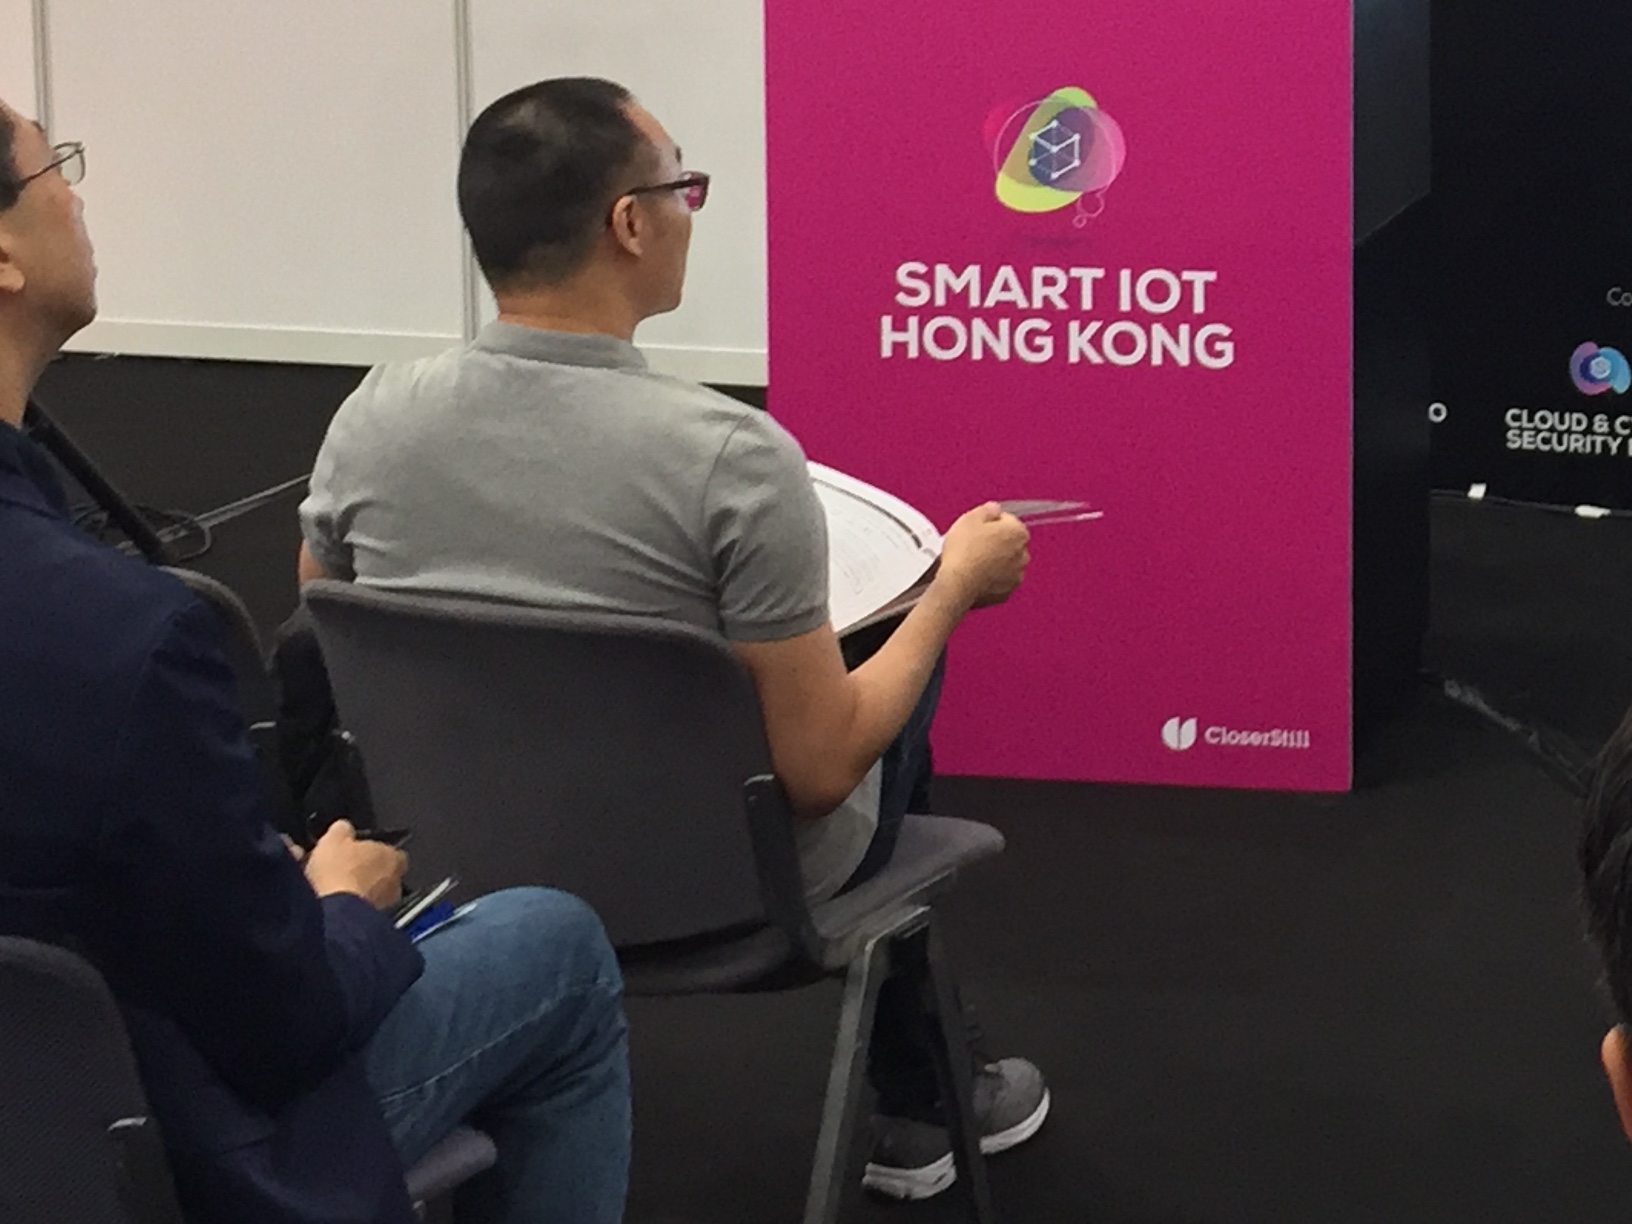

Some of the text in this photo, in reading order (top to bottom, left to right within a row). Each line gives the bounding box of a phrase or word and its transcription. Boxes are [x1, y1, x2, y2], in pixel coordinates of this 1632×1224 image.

[895, 261, 1218, 315] SMART IOT
[880, 315, 1235, 369] HONG KONG
[1505, 408, 1588, 433] CLOUD
[1592, 414, 1609, 434] &
[1506, 429, 1622, 456] SECURITY
[1204, 726, 1310, 749] CloserStill
